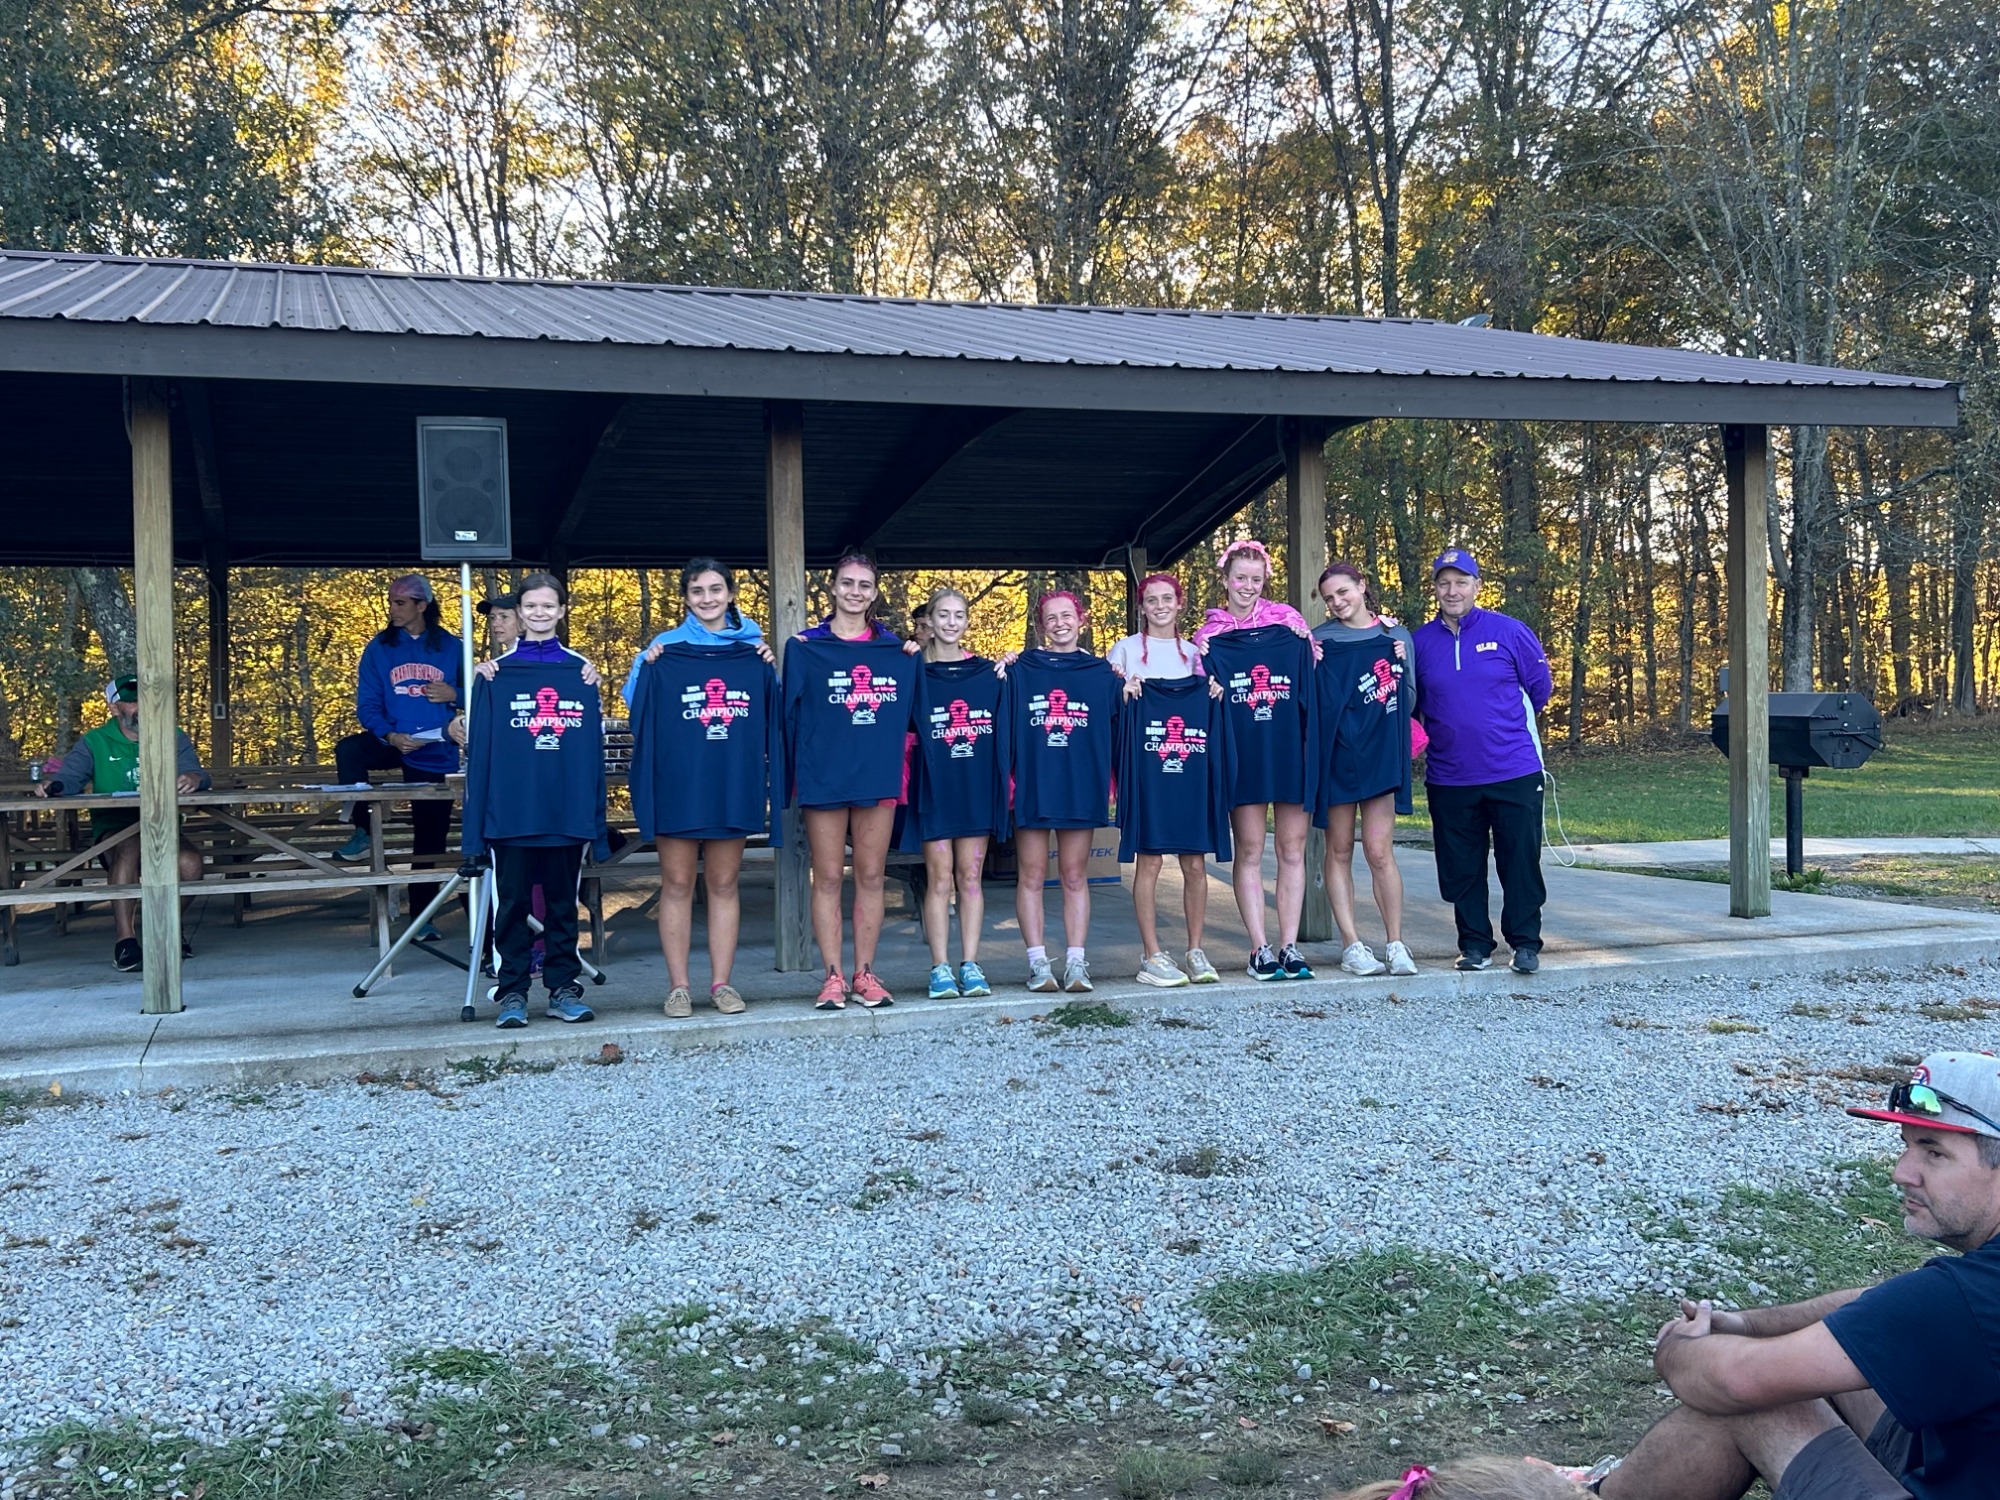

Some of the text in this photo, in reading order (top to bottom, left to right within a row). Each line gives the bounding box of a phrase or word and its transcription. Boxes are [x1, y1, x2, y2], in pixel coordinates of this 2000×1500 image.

[1230, 678, 1252, 688] BUNNY
[828, 692, 898, 704] CHAMPIONS
[1231, 690, 1290, 704] CHAMPIONS
[682, 706, 749, 720] CHAMPIONS
[510, 717, 582, 728] CHAMPIONS
[1030, 715, 1088, 728] CHAMPIONS
[932, 724, 993, 739] CHAMPIONS
[1144, 742, 1206, 754] CHAMPIONS
